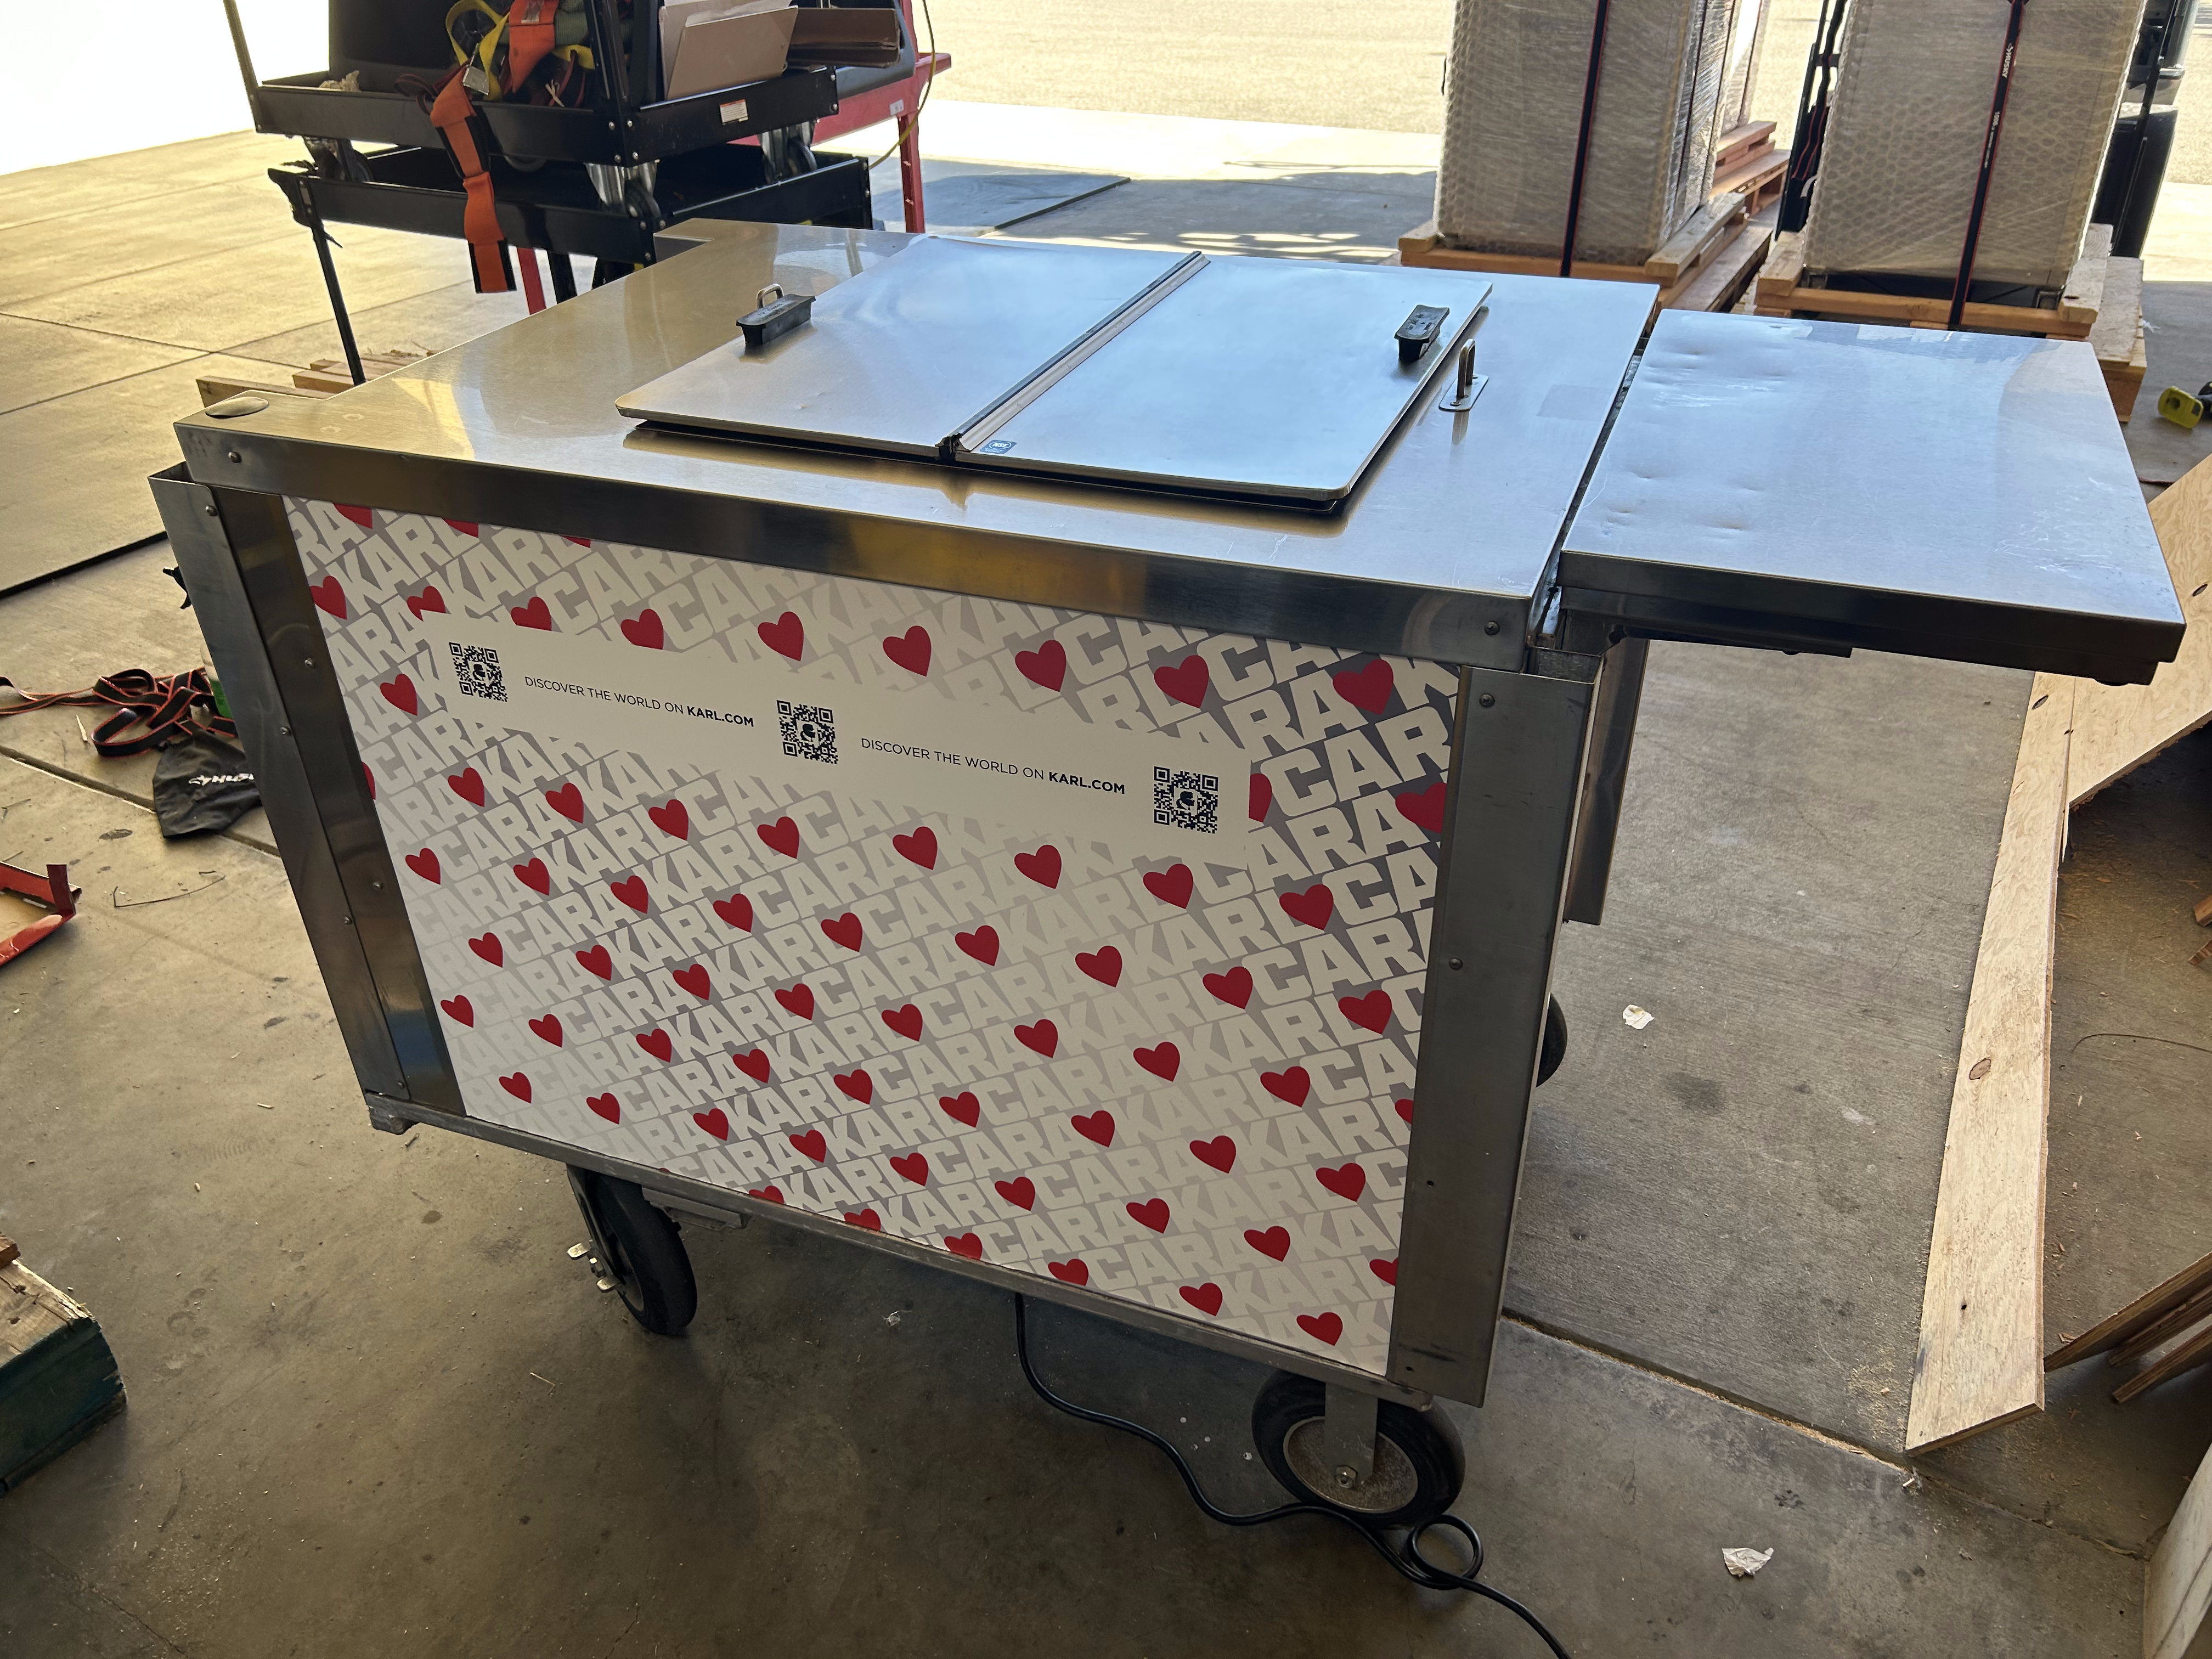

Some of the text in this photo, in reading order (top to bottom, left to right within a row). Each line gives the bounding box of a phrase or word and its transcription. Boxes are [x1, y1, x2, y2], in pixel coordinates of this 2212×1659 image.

[2002, 52, 2012, 78] HUSKY
[325, 595, 430, 692] ARA
[651, 559, 837, 651] CAR
[524, 675, 754, 727] DISCOVER THE WORLD ON KARL.COM
[211, 772, 255, 783] HUS
[374, 773, 478, 854] ARA
[466, 733, 617, 804] KAR
[861, 737, 1125, 794] DISCOVER THE WORLD ON KARL.COM
[404, 862, 542, 946] CARA
[531, 804, 689, 893] KARL
[426, 788, 576, 881] CARA
[550, 967, 701, 1044] CARA
[693, 915, 860, 997] KARL
[850, 849, 1046, 947] CARA
[1261, 707, 1451, 815] CAR
[460, 948, 604, 1025] CARA
[594, 897, 752, 978] KARL
[740, 831, 923, 928] CARA
[489, 879, 640, 964] CARA
[630, 821, 798, 910] KARL
[491, 1093, 620, 1142] ARL
[608, 1051, 760, 1121] CARA
[753, 1006, 920, 1081] KARL
[911, 950, 1106, 1038] CARA
[1106, 889, 1325, 985] KARL
[520, 1030, 663, 1101] CARA
[655, 986, 812, 1060] KARL
[802, 929, 985, 1017] CARA
[982, 868, 1187, 963] KARL
[714, 1071, 870, 1140] KARL
[861, 1023, 1043, 1102] CARA
[1042, 970, 1246, 1057] KARL
[1242, 908, 1434, 1006] CAR
[811, 1093, 977, 1162] KARL
[969, 1046, 1164, 1126] CARA
[1165, 994, 1383, 1081] KARL
[917, 1113, 1100, 1185] CARA
[1101, 1069, 1303, 1147] KARL
[867, 1178, 1032, 1238] KARL
[1025, 1138, 1219, 1209] CARA
[972, 1199, 1154, 1264] CARA
[1155, 1163, 1357, 1233] KARL
[1079, 1226, 1272, 1290] CARA
